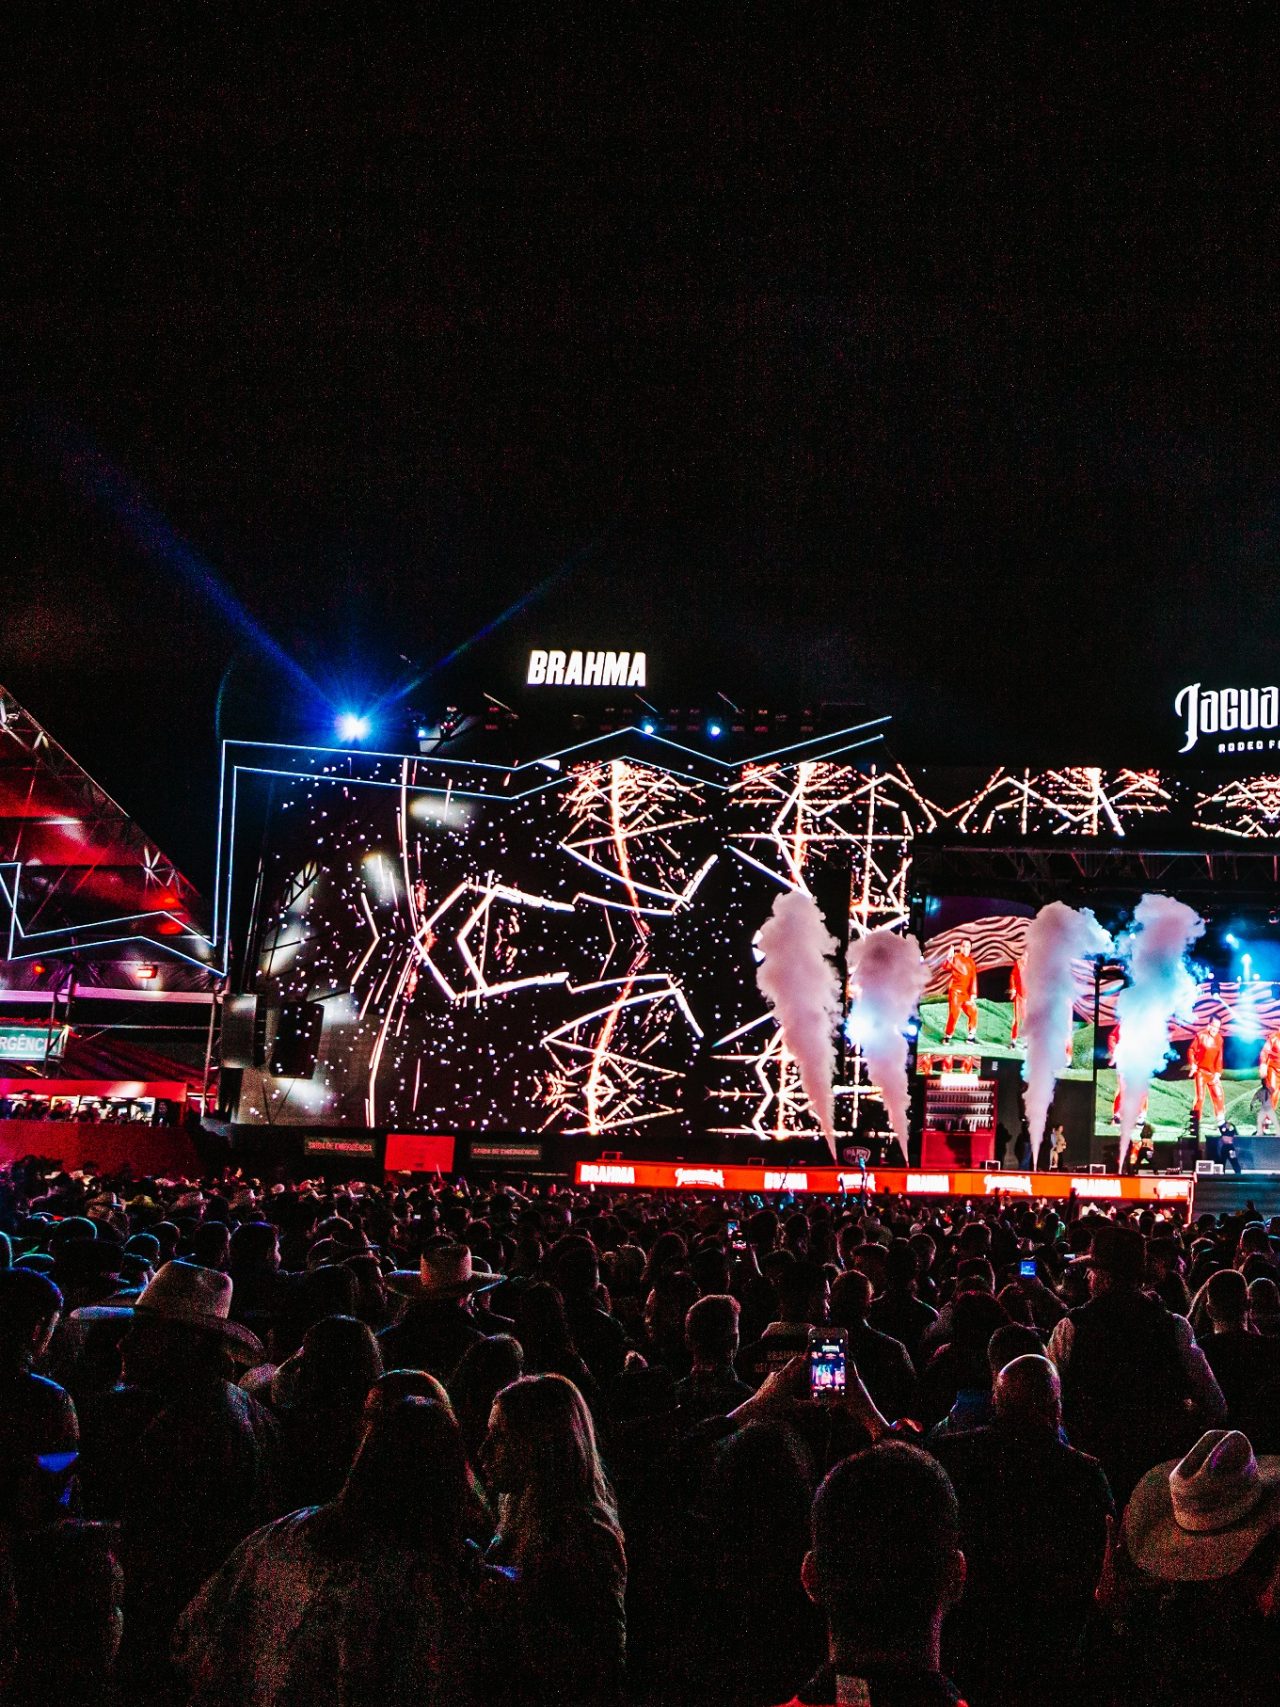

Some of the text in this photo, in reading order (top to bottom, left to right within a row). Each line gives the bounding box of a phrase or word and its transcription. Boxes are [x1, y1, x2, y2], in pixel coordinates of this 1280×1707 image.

[527, 650, 647, 687] BRAHMA
[1218, 741, 1264, 754] RODEO
[581, 1165, 635, 1183] BRAHMA
